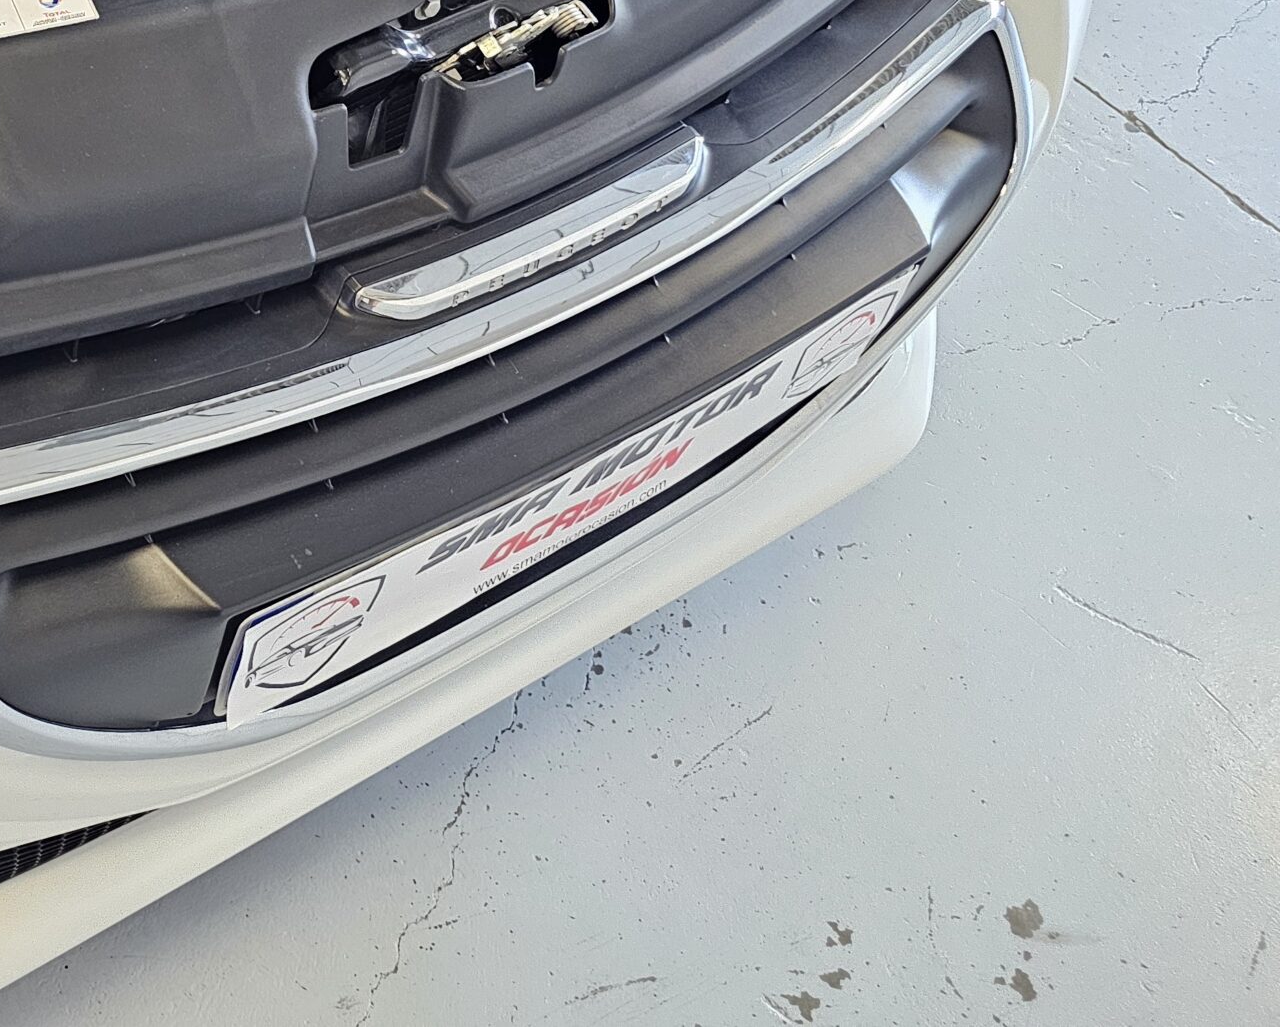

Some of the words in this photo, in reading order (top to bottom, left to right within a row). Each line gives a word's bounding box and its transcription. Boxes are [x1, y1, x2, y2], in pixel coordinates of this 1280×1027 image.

[43, 9, 72, 18] TOTAL
[415, 476, 572, 576] SMA
[568, 360, 784, 496] MOTOR
[472, 478, 667, 595] www.smamotorocasion.com
